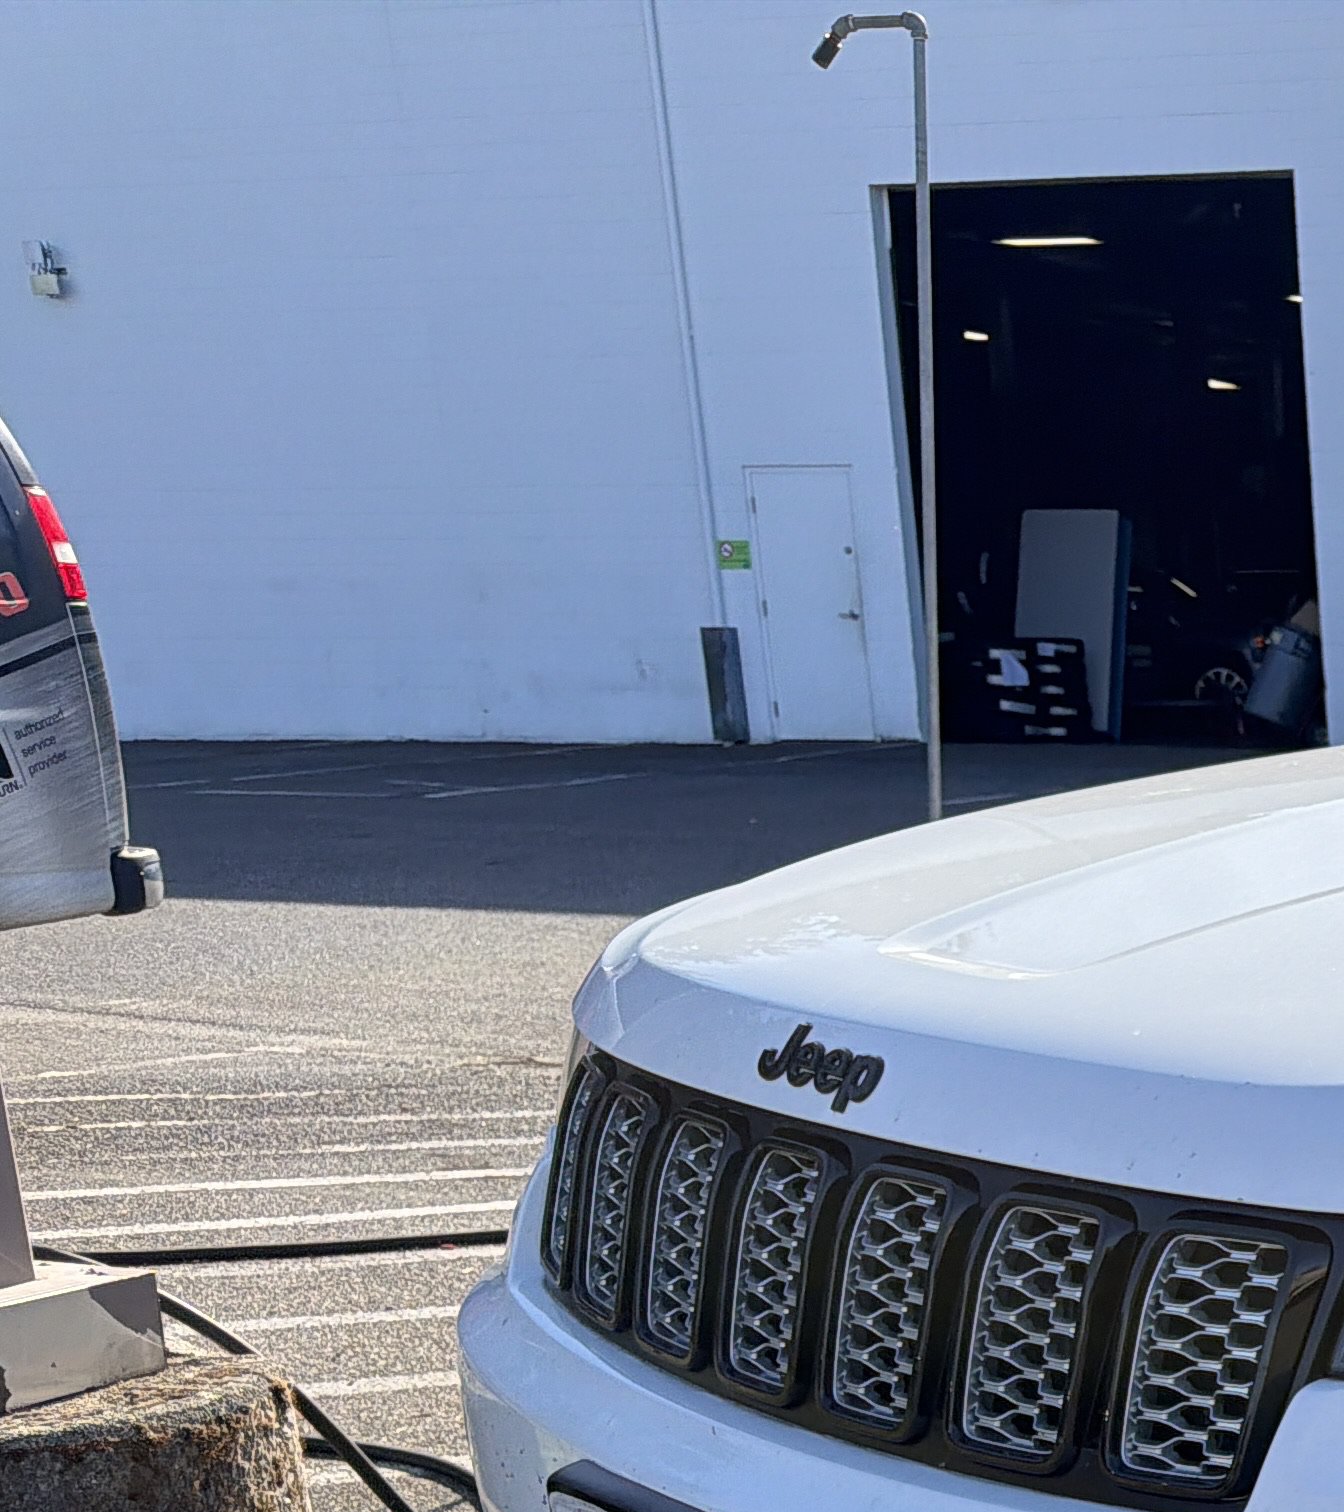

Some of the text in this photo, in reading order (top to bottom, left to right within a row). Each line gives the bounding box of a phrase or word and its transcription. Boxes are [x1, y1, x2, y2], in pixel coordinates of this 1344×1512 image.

[14, 706, 65, 740] authorized
[21, 735, 57, 757] service
[28, 750, 68, 778] provider
[757, 1022, 885, 1114] Jeep
